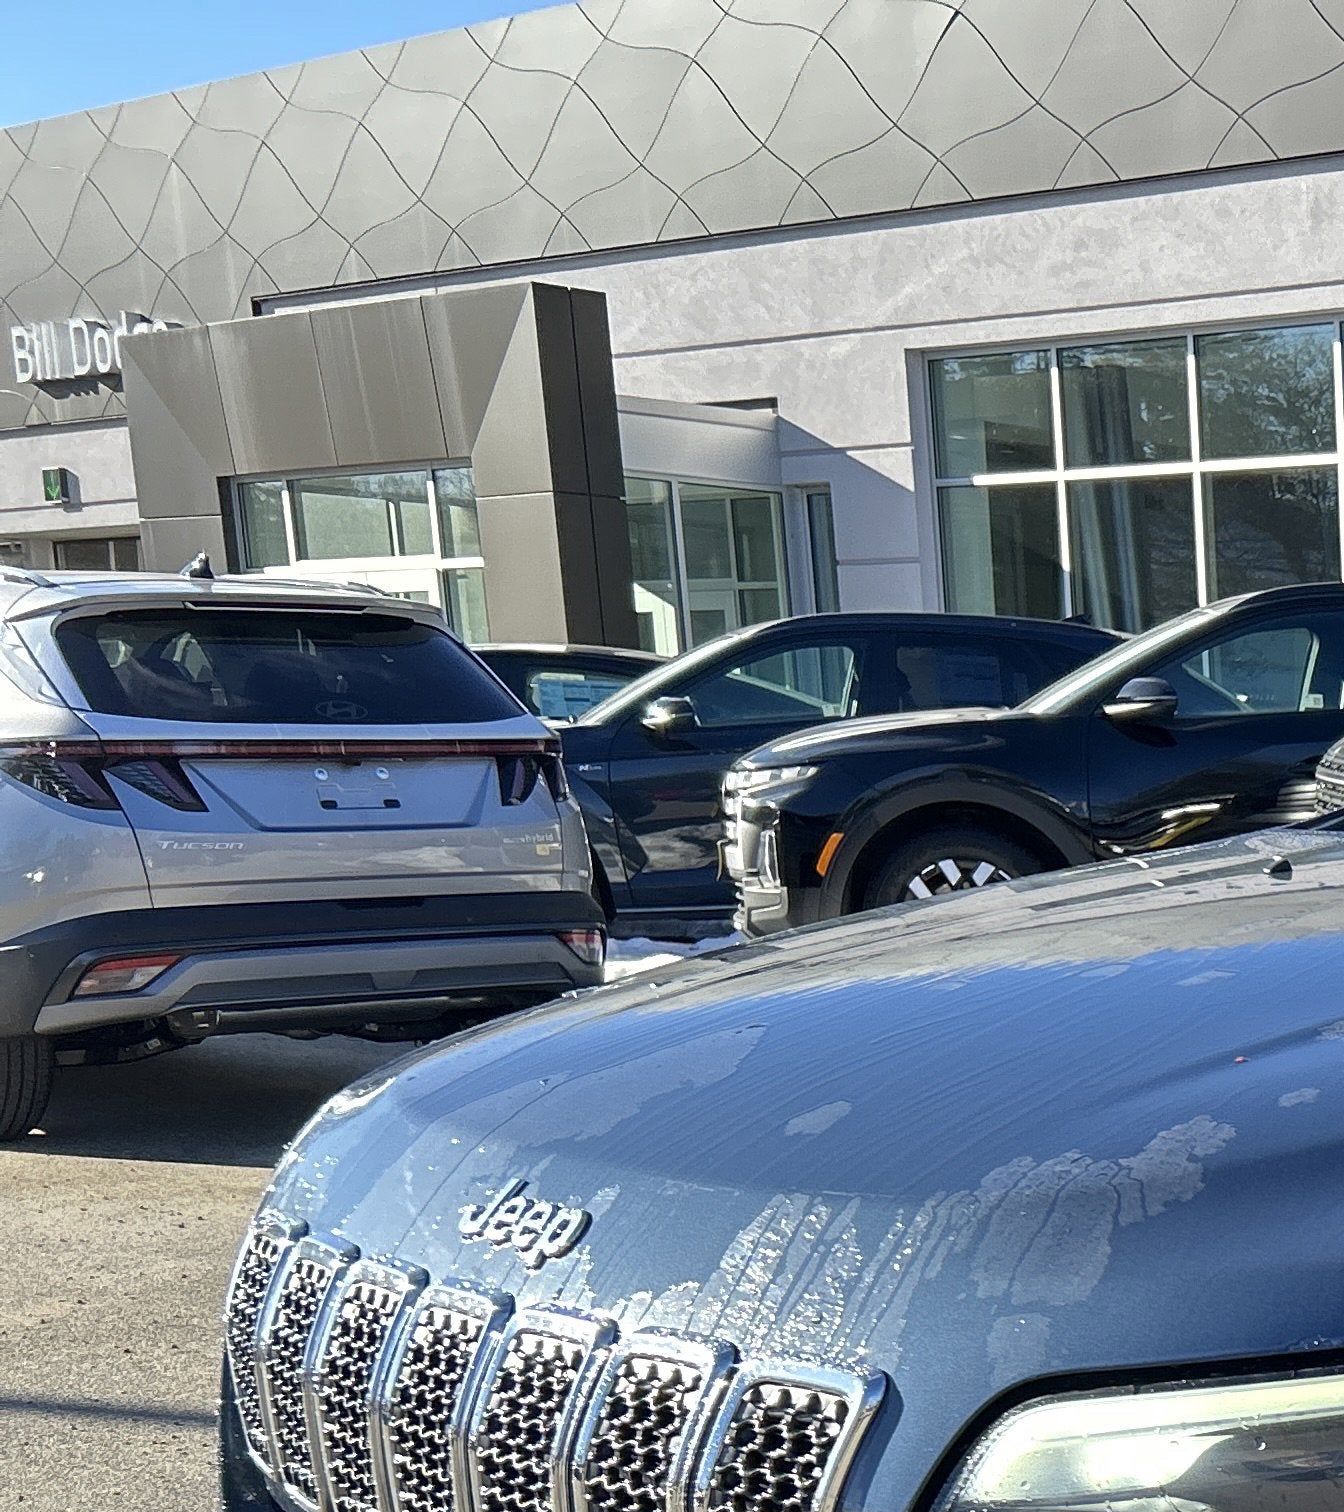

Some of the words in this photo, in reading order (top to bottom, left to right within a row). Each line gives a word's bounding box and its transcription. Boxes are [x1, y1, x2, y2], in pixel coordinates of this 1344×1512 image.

[11, 321, 60, 383] Bill
[68, 310, 168, 376] Dod
[458, 1177, 593, 1270] Jeep
